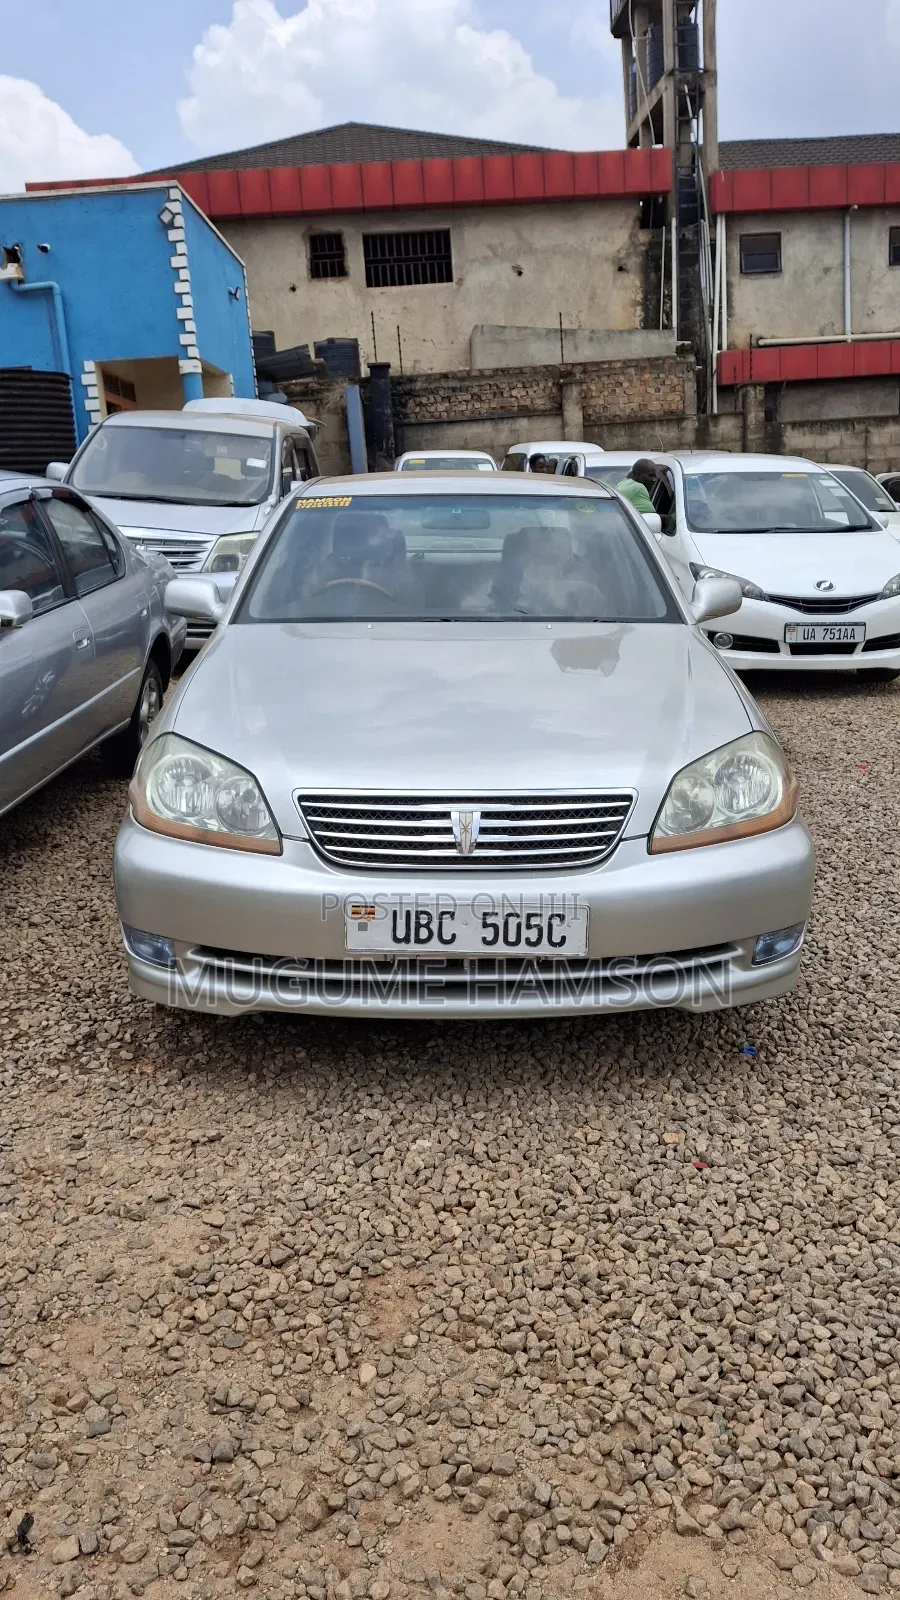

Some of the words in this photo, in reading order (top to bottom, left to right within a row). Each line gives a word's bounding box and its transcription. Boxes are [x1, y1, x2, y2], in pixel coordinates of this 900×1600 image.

[803, 628, 816, 641] UA
[822, 628, 856, 641] 751AA
[391, 909, 457, 945] UBC
[481, 911, 567, 948] 505C
